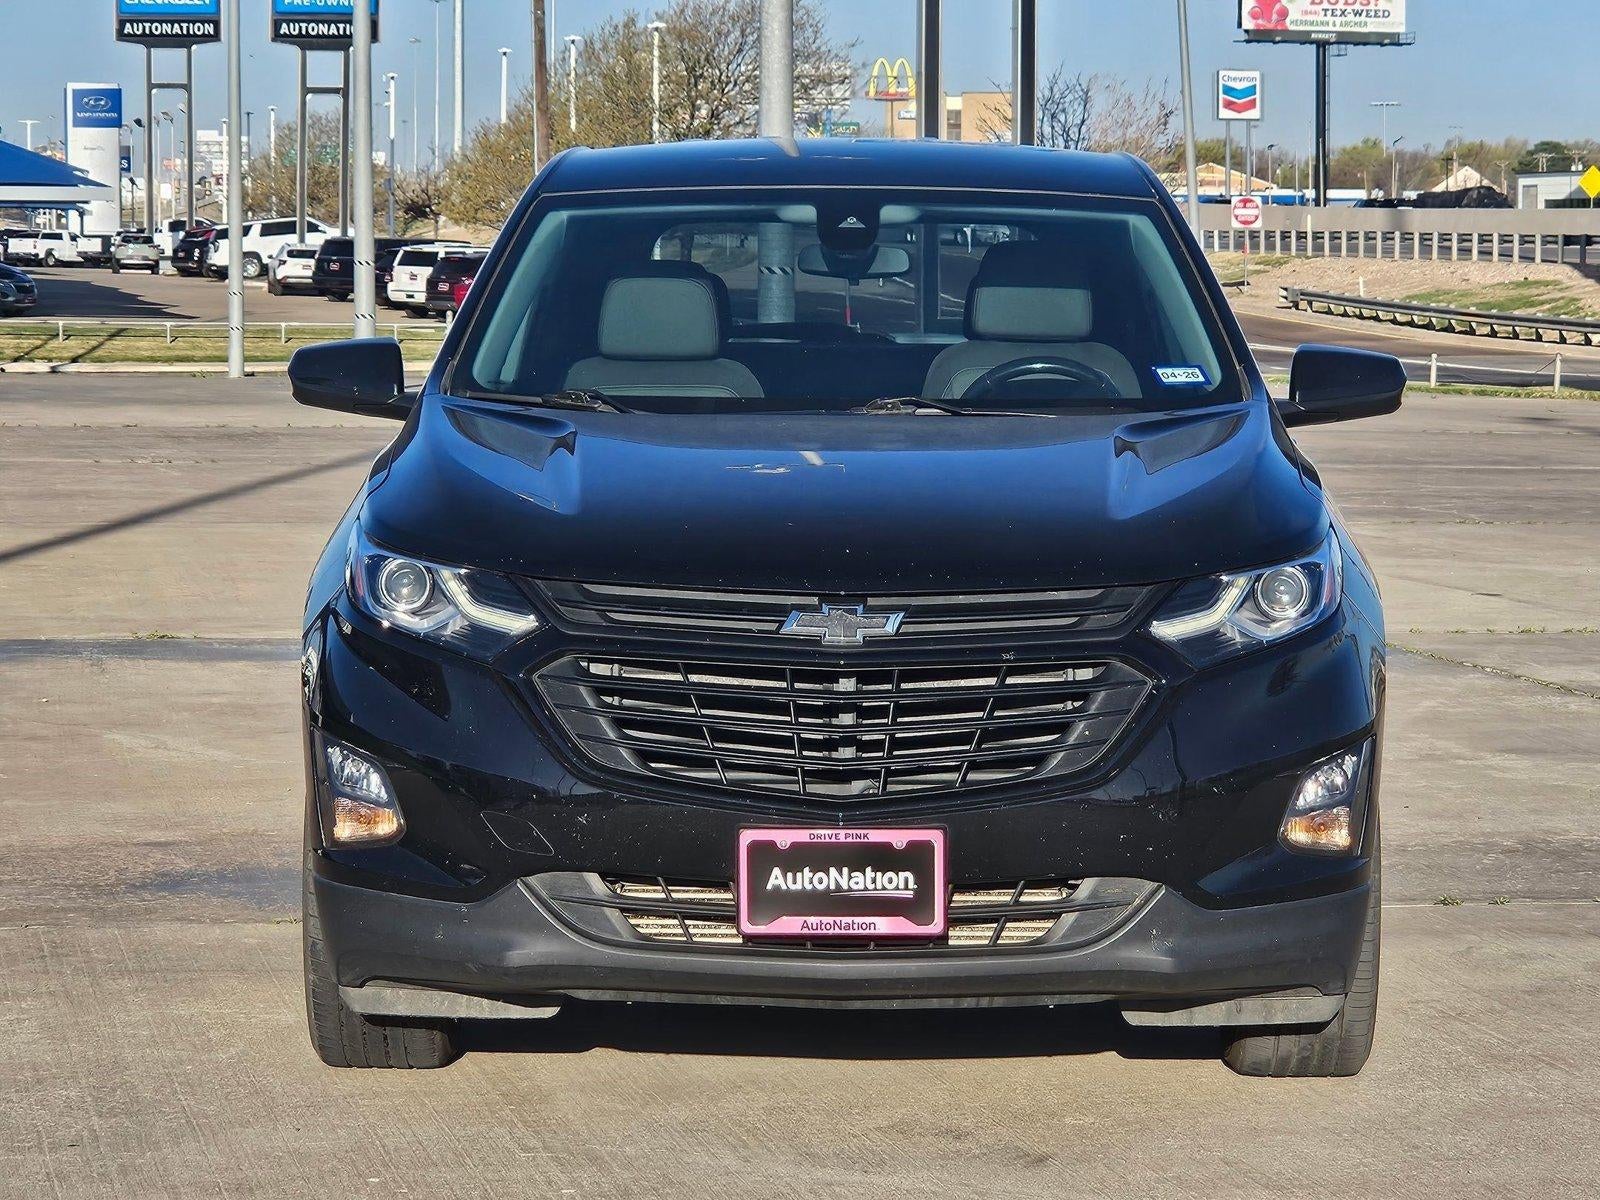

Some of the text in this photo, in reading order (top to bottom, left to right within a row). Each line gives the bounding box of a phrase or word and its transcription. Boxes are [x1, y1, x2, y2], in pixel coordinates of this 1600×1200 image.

[1321, 8, 1391, 19] TEX-WEED
[123, 22, 215, 36] AUTONATION
[280, 22, 354, 36] AUTONATI
[1221, 74, 1257, 83] Chevron
[1161, 371, 1200, 380] 04-26
[808, 832, 870, 841] DRIVE PINK
[800, 919, 877, 932] AutoNation
